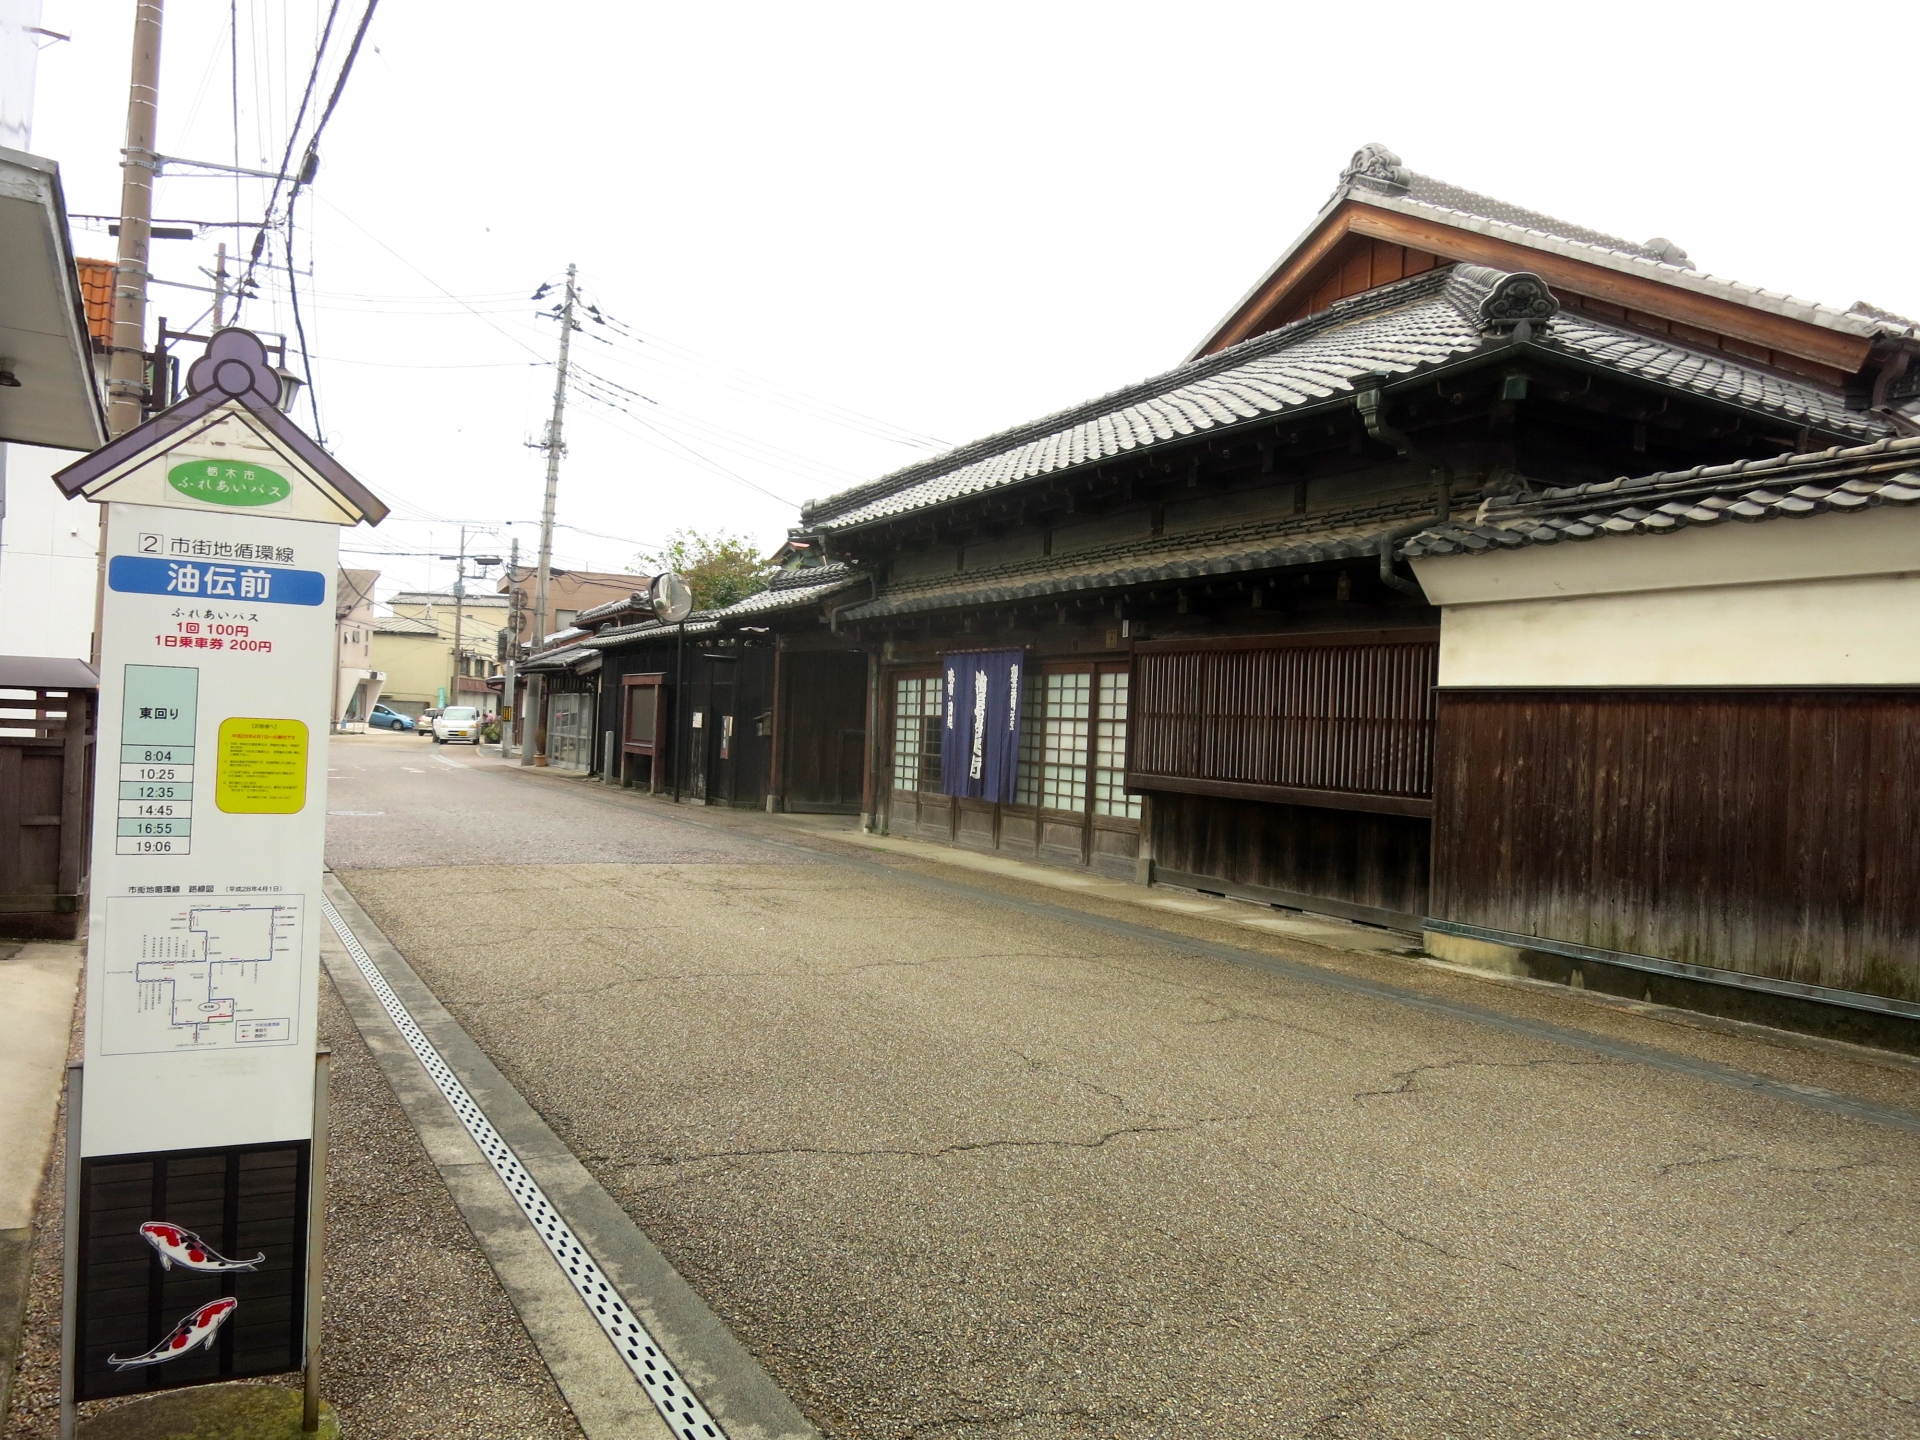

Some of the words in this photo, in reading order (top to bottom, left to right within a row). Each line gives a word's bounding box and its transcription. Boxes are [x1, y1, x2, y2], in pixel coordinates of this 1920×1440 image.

[206, 465, 256, 481] 栃木市
[177, 476, 282, 498] ふれあいバス
[143, 536, 159, 553] 2
[170, 537, 295, 563] 市街地循環線
[167, 563, 272, 599] 油伝前
[171, 608, 259, 622] ふれあいバス
[176, 622, 200, 634] 1回
[207, 624, 249, 638] 100円
[155, 635, 224, 650] 1日乗車券
[229, 639, 272, 653] 200円
[139, 706, 180, 720] 東回り
[144, 750, 172, 762] 8:04
[140, 769, 175, 780] 10:25
[139, 787, 175, 798] 12:35
[138, 805, 174, 816] 14:45
[137, 823, 173, 834] 16:55
[136, 841, 172, 852] 19:06
[128, 885, 181, 895] 市街地循環線
[188, 884, 215, 894] 路線図
